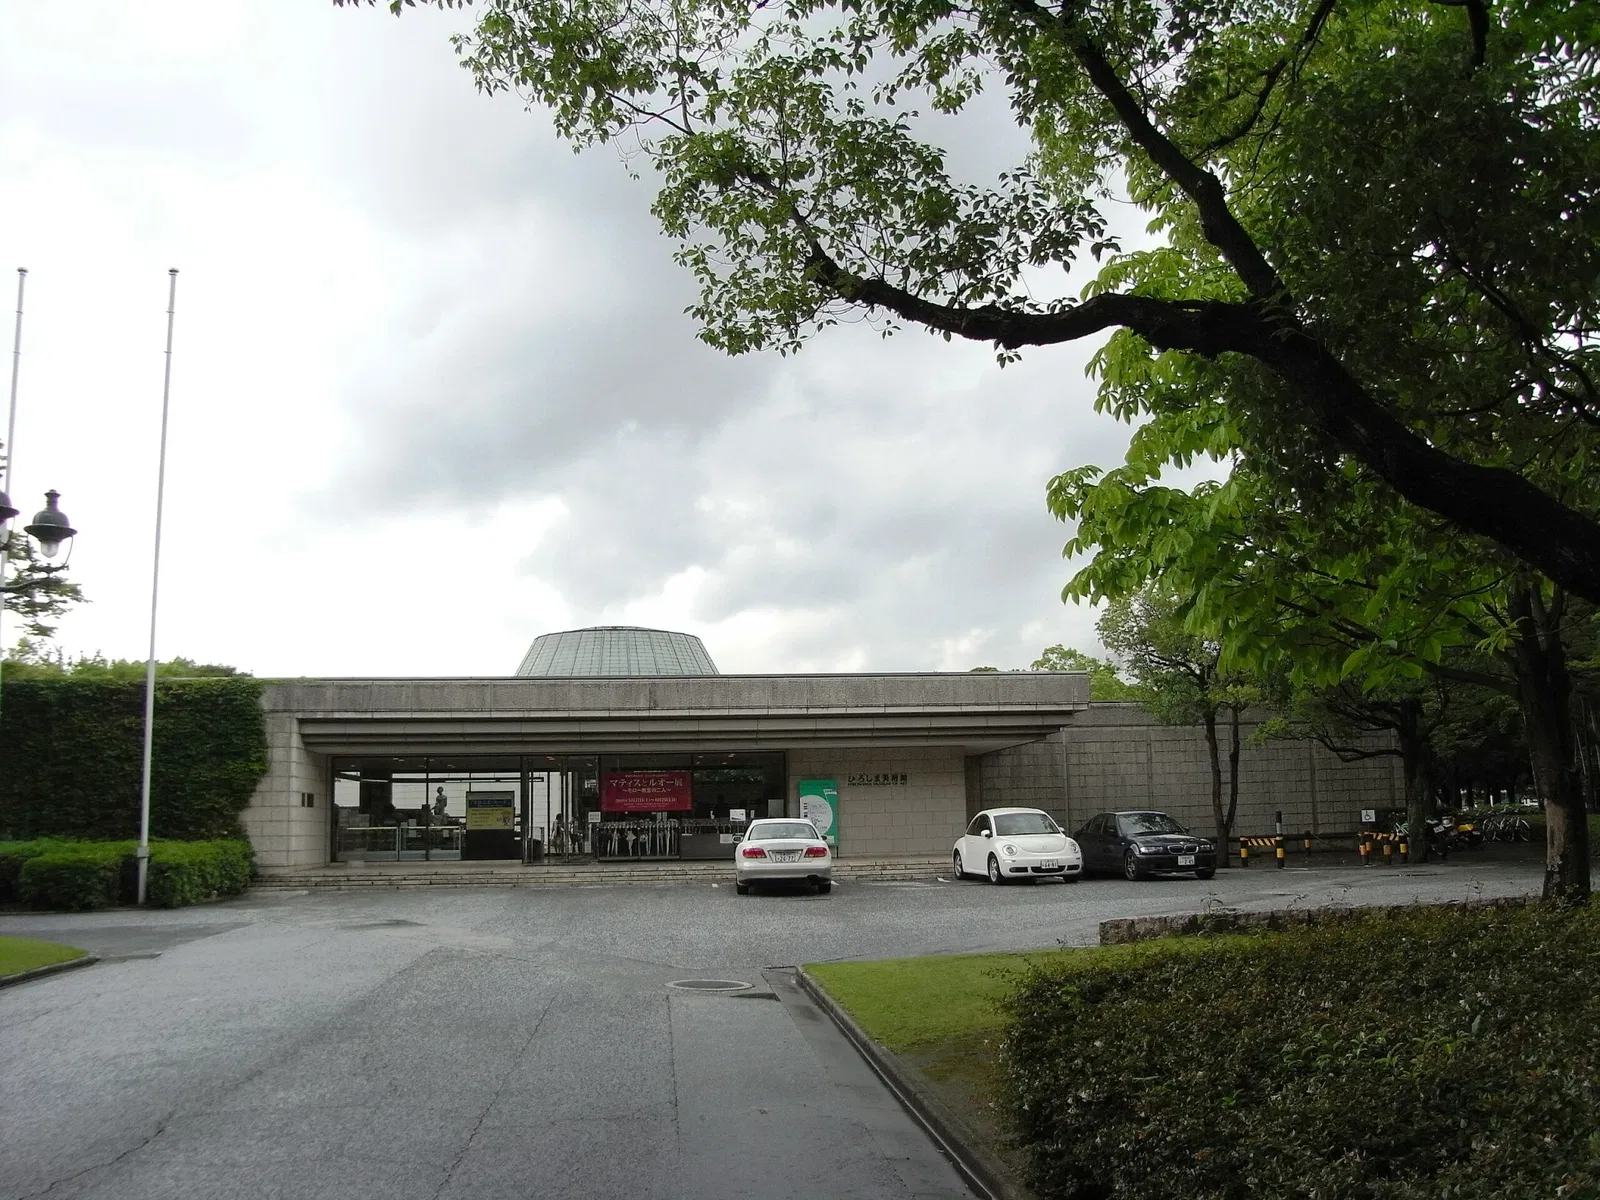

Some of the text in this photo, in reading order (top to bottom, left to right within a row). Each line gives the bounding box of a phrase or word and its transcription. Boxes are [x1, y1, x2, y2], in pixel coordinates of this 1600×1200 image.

[848, 773, 908, 782] ひろしま美術館
[609, 778, 683, 787] マティスとルオー展
